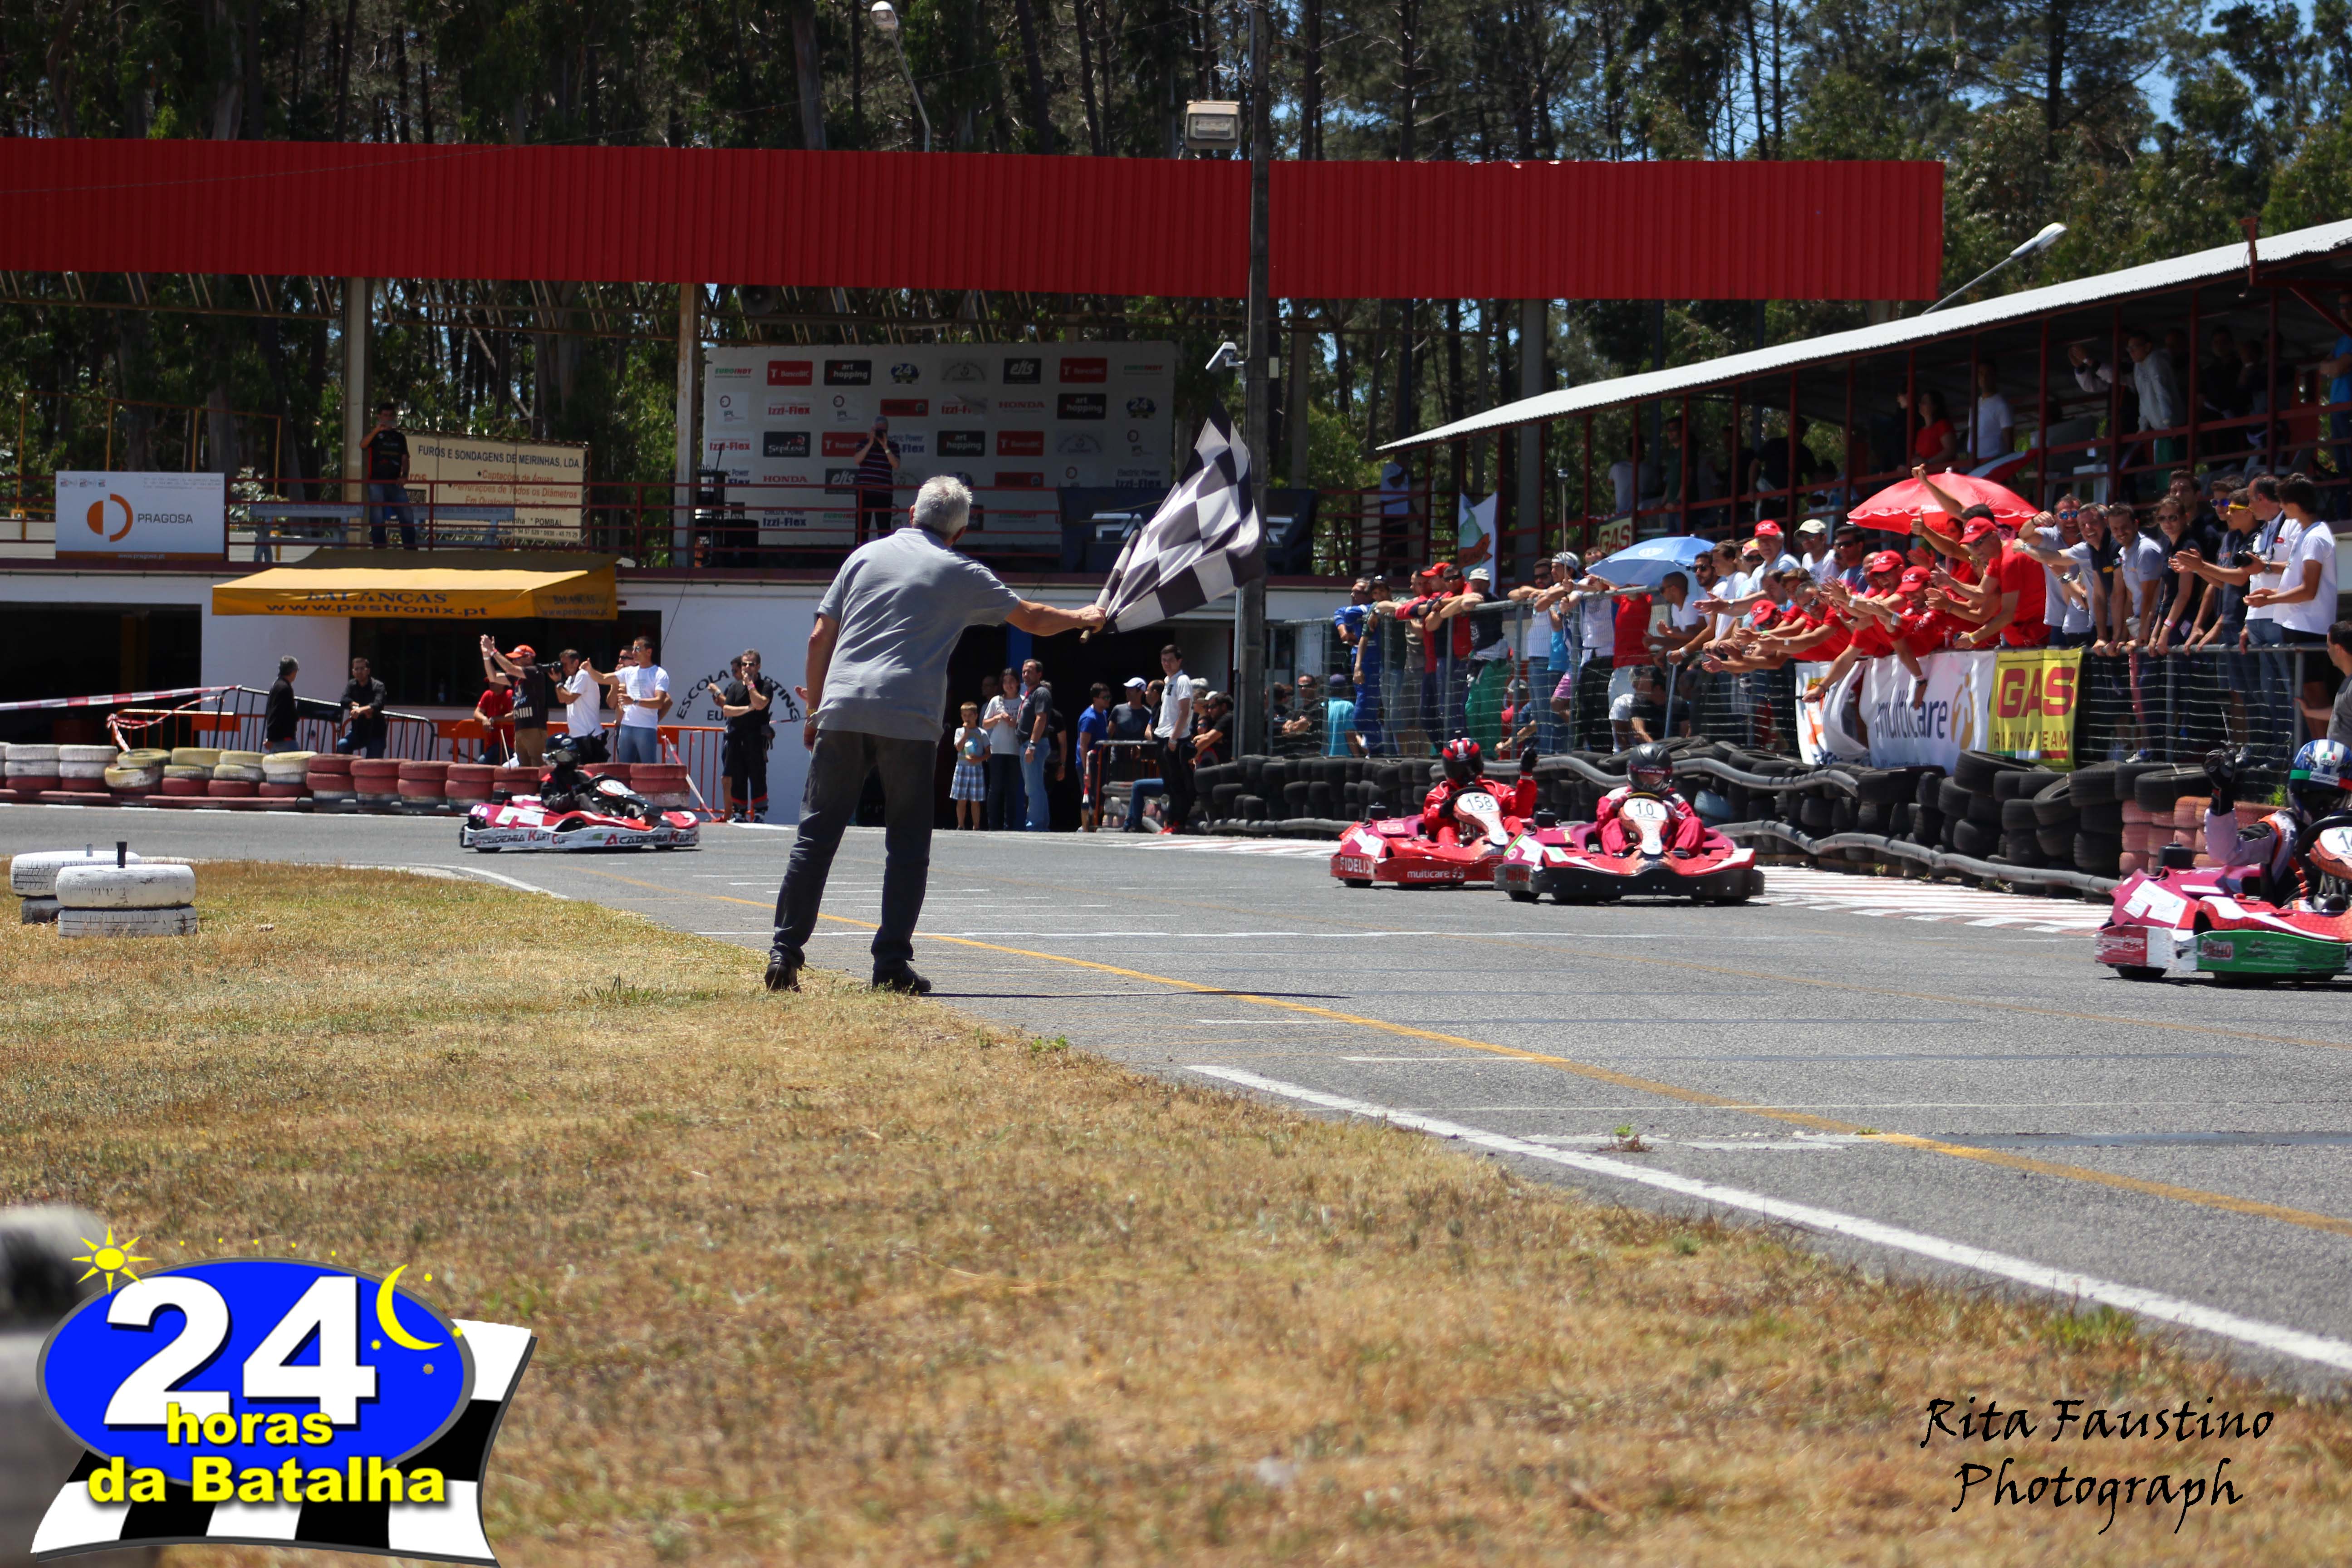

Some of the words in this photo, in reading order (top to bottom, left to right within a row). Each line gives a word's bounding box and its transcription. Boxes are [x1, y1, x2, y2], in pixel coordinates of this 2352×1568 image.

[418, 445, 445, 458] FUROS
[448, 449, 453, 459] E
[455, 450, 504, 464] SONDAGENS
[506, 454, 517, 463] DE
[137, 513, 193, 524] PRAGOSA
[266, 603, 488, 617] www.pestronix.pt
[676, 669, 730, 720] ESCOLA
[1997, 666, 2076, 718] GAS
[1466, 796, 1493, 810] 158
[1635, 802, 1654, 816] 10
[2337, 831, 2352, 850] 1
[1407, 870, 1450, 879] multicare
